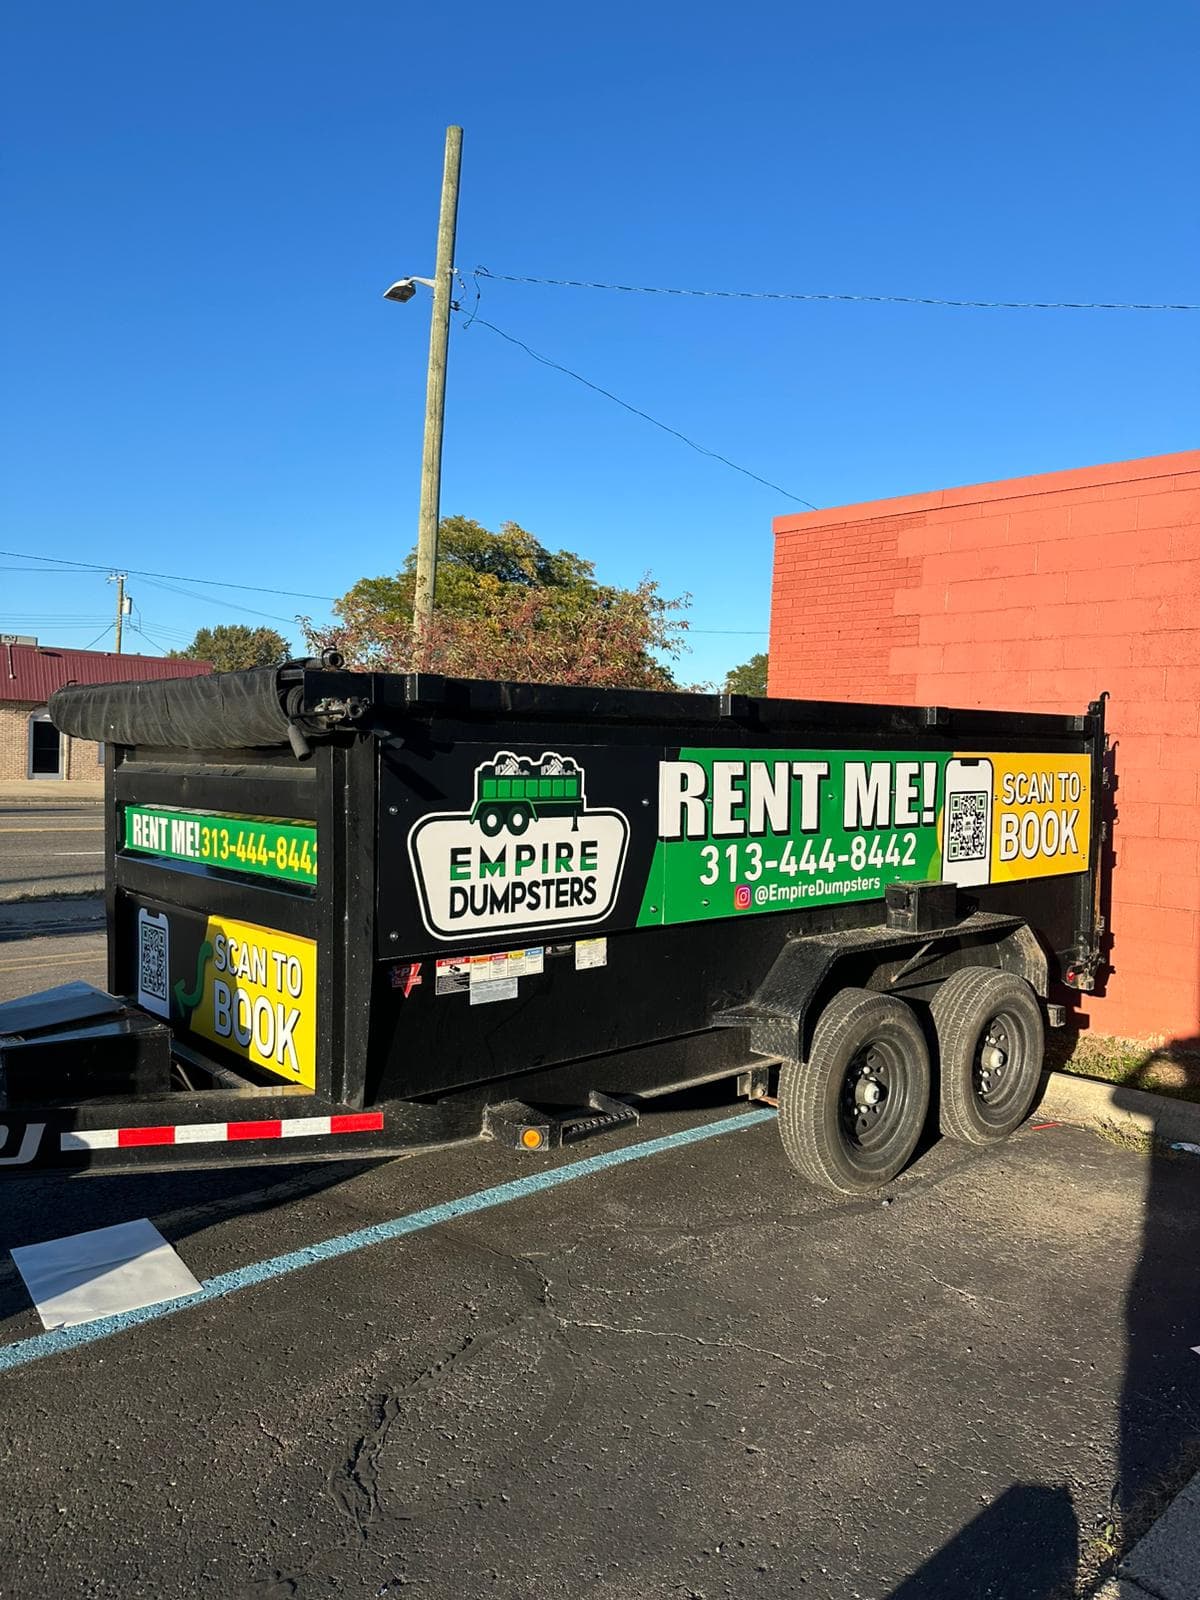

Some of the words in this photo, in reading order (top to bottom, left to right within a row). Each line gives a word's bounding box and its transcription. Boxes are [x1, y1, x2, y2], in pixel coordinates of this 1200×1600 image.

[658, 760, 829, 841] RENT
[843, 761, 937, 832] ME!
[1002, 772, 1054, 805] SCAN
[1058, 771, 1081, 803] TO
[132, 813, 168, 851] RENT
[171, 819, 200, 858] ME!
[700, 832, 916, 886] 313-444-8442
[1000, 809, 1080, 861] BOOK
[450, 840, 598, 881] EMPIRE
[449, 875, 597, 920] DUMPSTERS
[755, 876, 880, 905] @EmpireDumpsters
[214, 933, 267, 988] SCAN
[272, 951, 302, 999] TO
[213, 979, 301, 1073] BOOK
